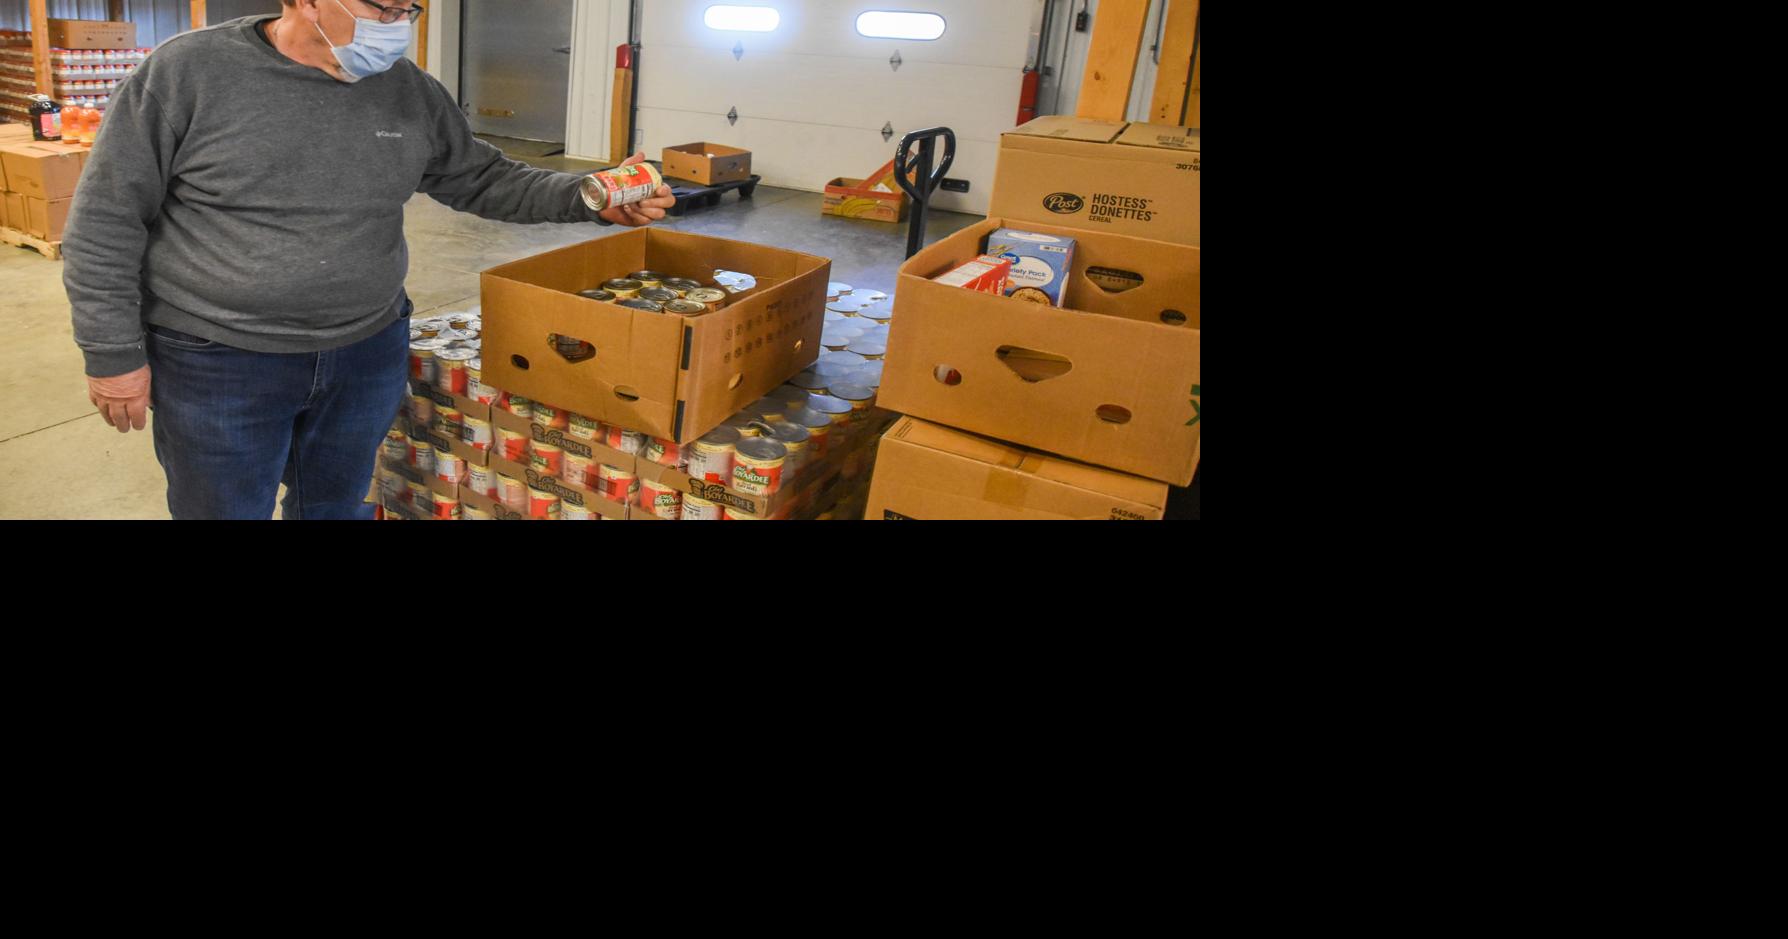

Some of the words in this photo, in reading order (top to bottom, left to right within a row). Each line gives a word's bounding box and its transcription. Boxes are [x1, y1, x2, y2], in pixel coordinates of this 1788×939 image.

[1048, 195, 1079, 209] Post
[1092, 193, 1148, 210] HOSTESS
[1088, 215, 1112, 224] CEREAL
[1090, 204, 1153, 222] DONETTES
[1028, 269, 1046, 277] Pack
[704, 489, 755, 513] BOYARDEE
